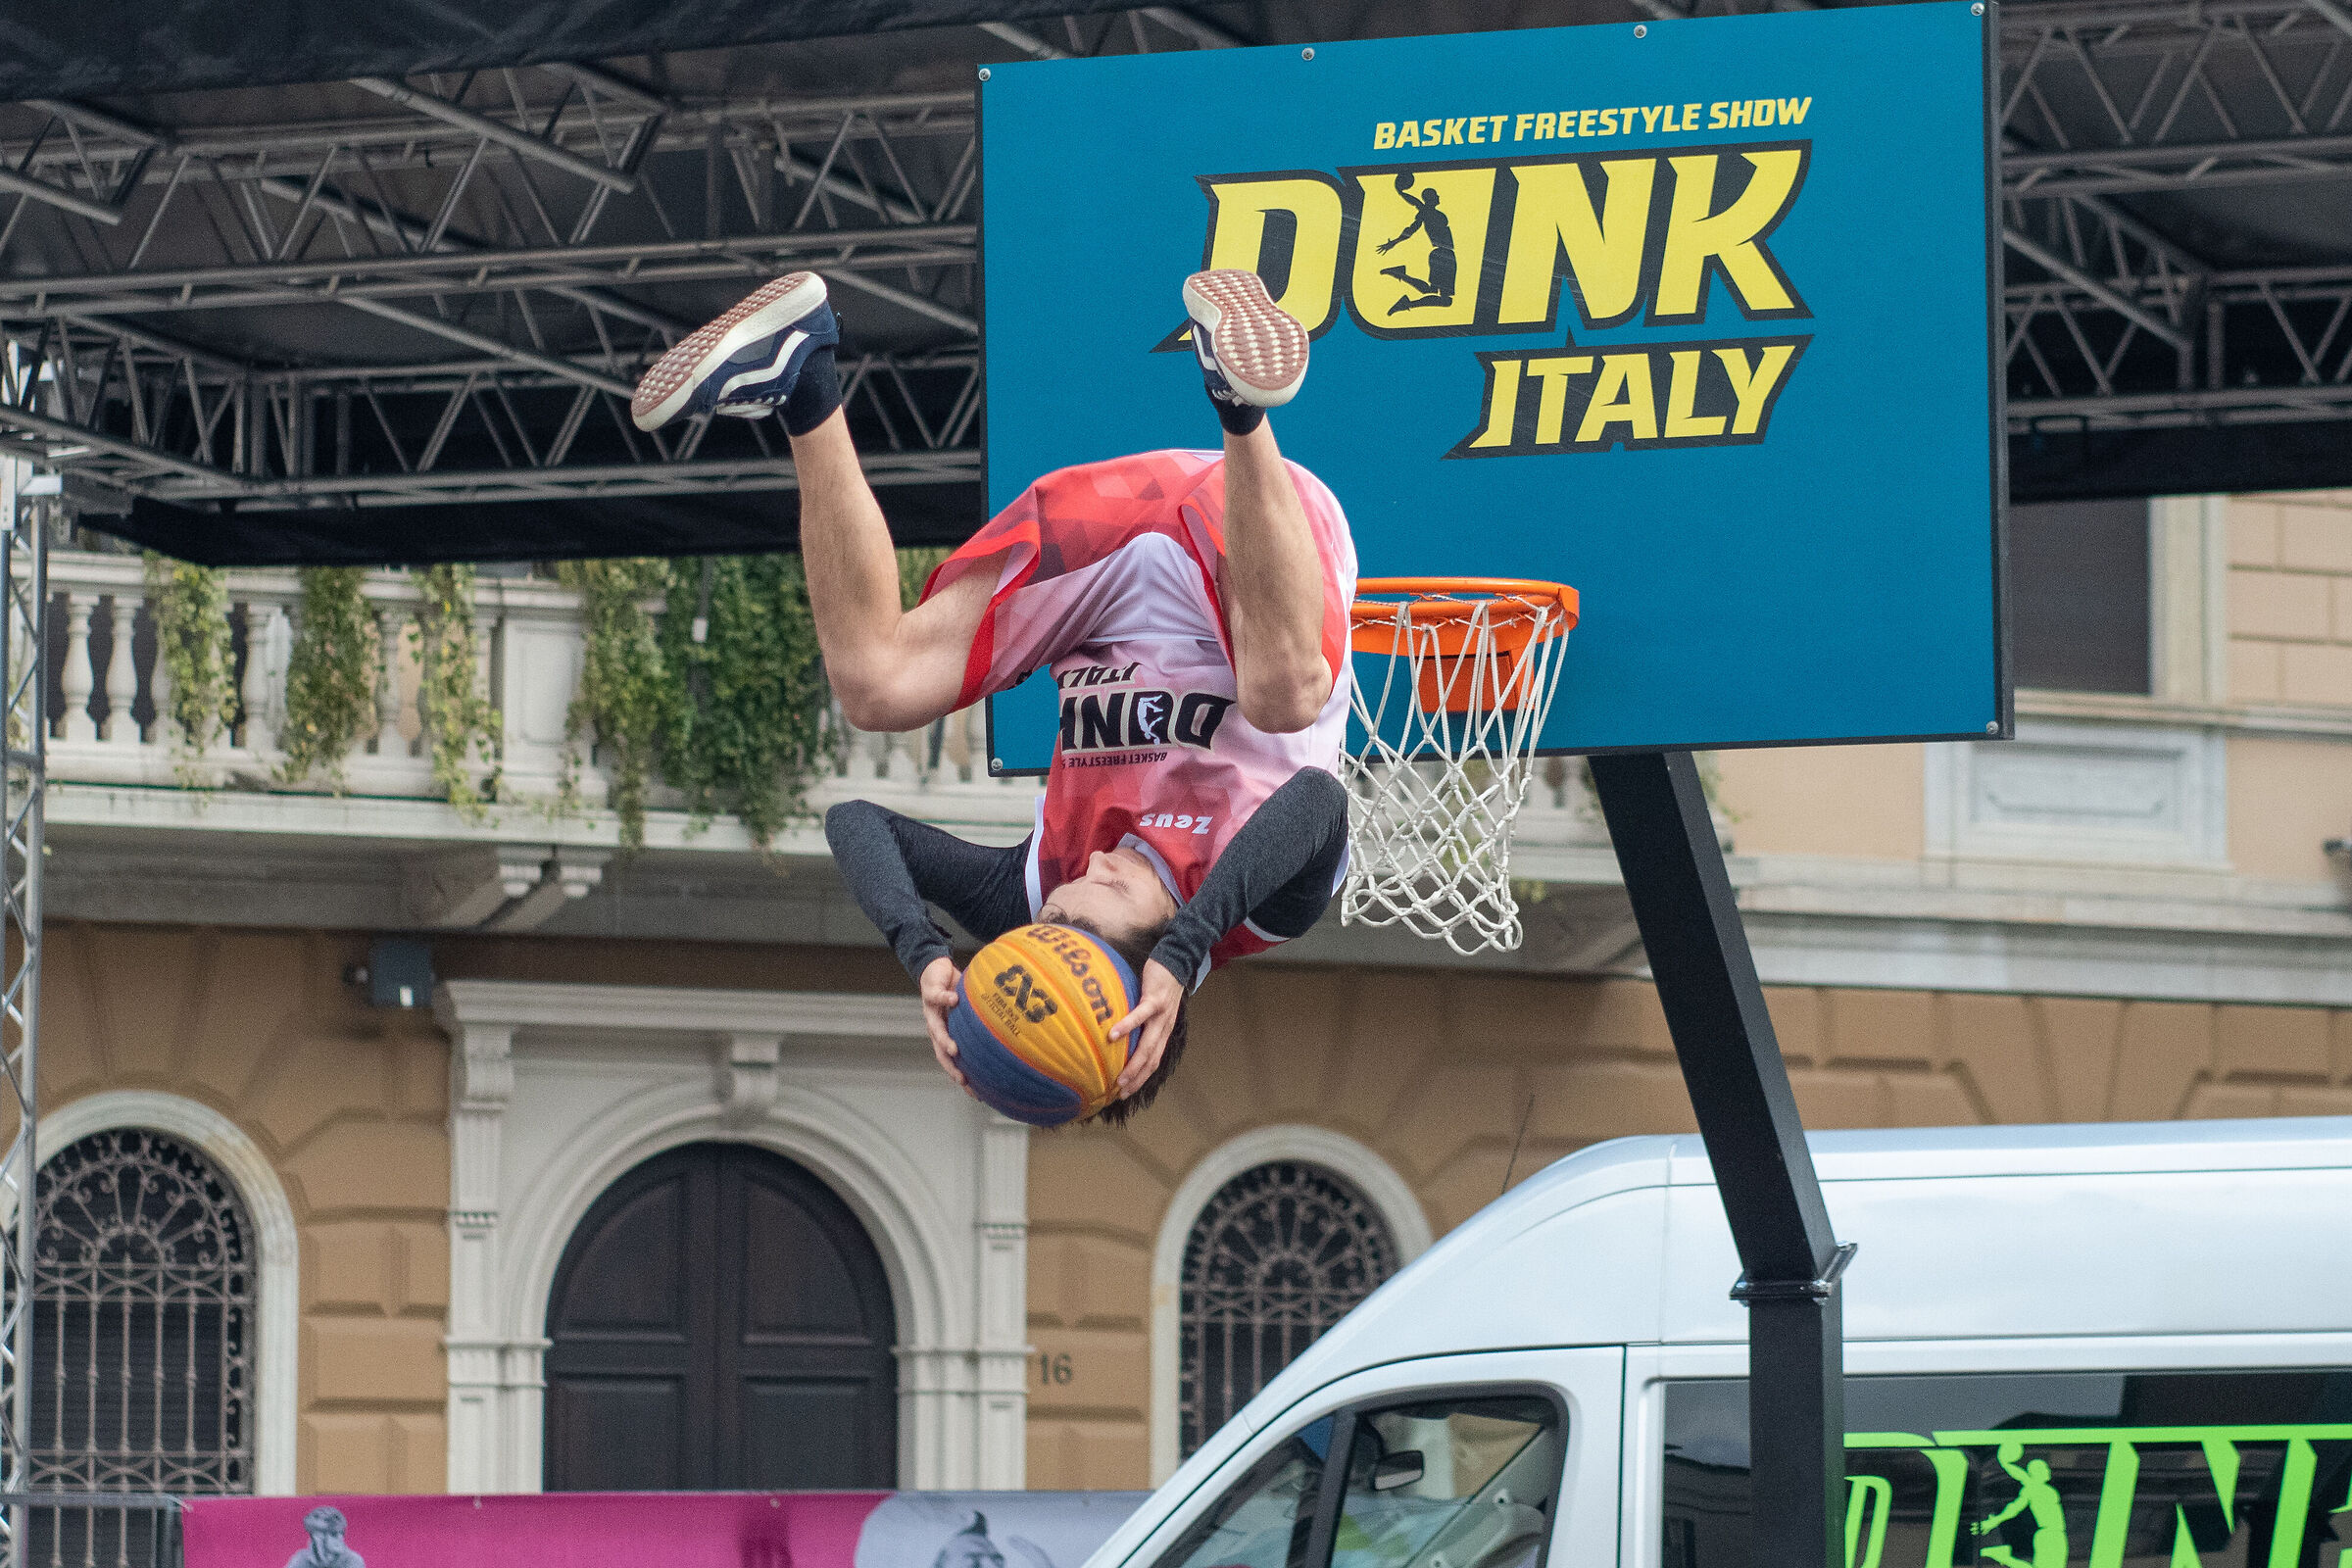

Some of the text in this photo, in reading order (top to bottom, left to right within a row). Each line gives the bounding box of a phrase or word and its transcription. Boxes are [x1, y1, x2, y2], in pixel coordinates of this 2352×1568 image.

[1373, 96, 1812, 150] BASKET FREESTYLE SHOW
[1176, 148, 1804, 342] DUNK
[1468, 344, 1796, 449] ITALY
[1068, 754, 1127, 768] FREESTYLE
[1128, 752, 1168, 765] BASKET
[1139, 812, 1213, 835] Zeus
[1026, 925, 1114, 1025] Wilson
[1004, 1017, 1022, 1038] BALL
[1041, 1353, 1072, 1386] 16
